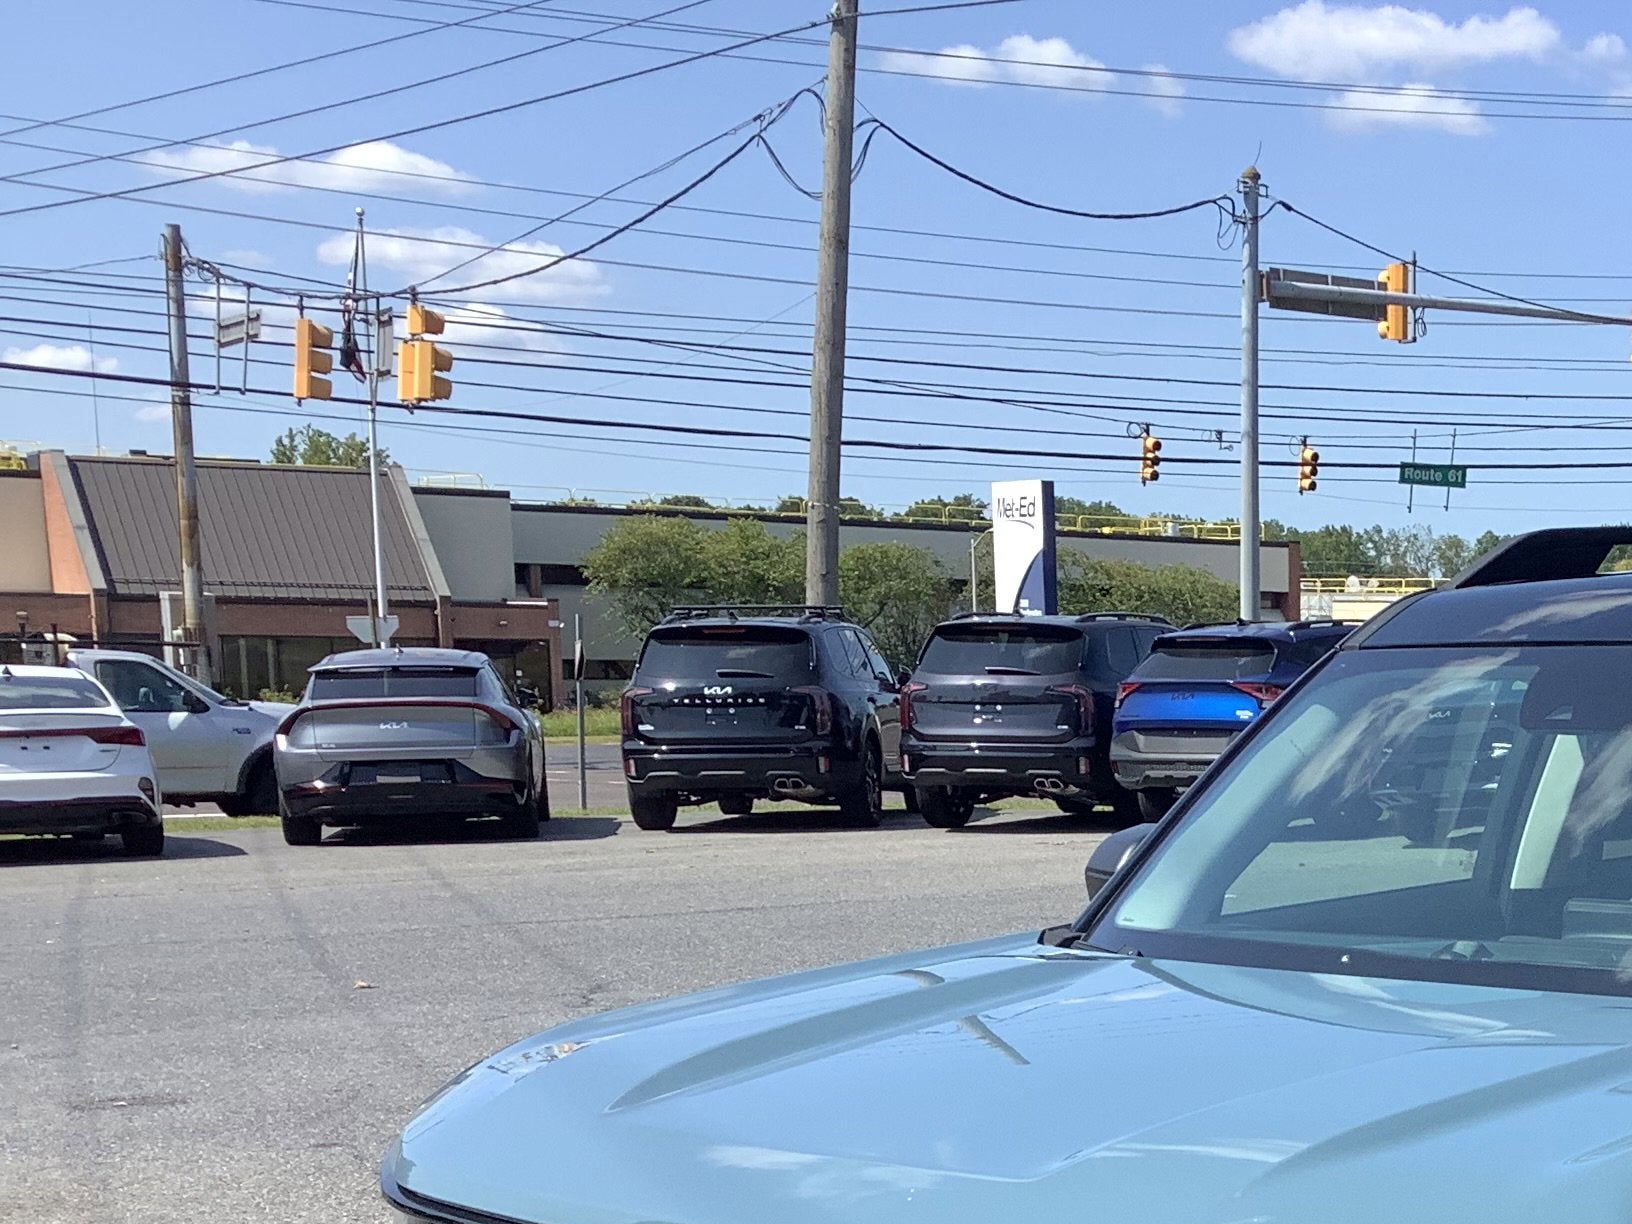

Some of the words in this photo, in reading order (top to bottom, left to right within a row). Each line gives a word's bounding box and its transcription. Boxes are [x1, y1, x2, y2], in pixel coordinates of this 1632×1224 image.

[1404, 467, 1443, 481] Route
[1447, 469, 1463, 483] 61
[997, 495, 1036, 518] Met-Ed
[704, 686, 733, 695] KIA
[379, 721, 408, 729] KIA
